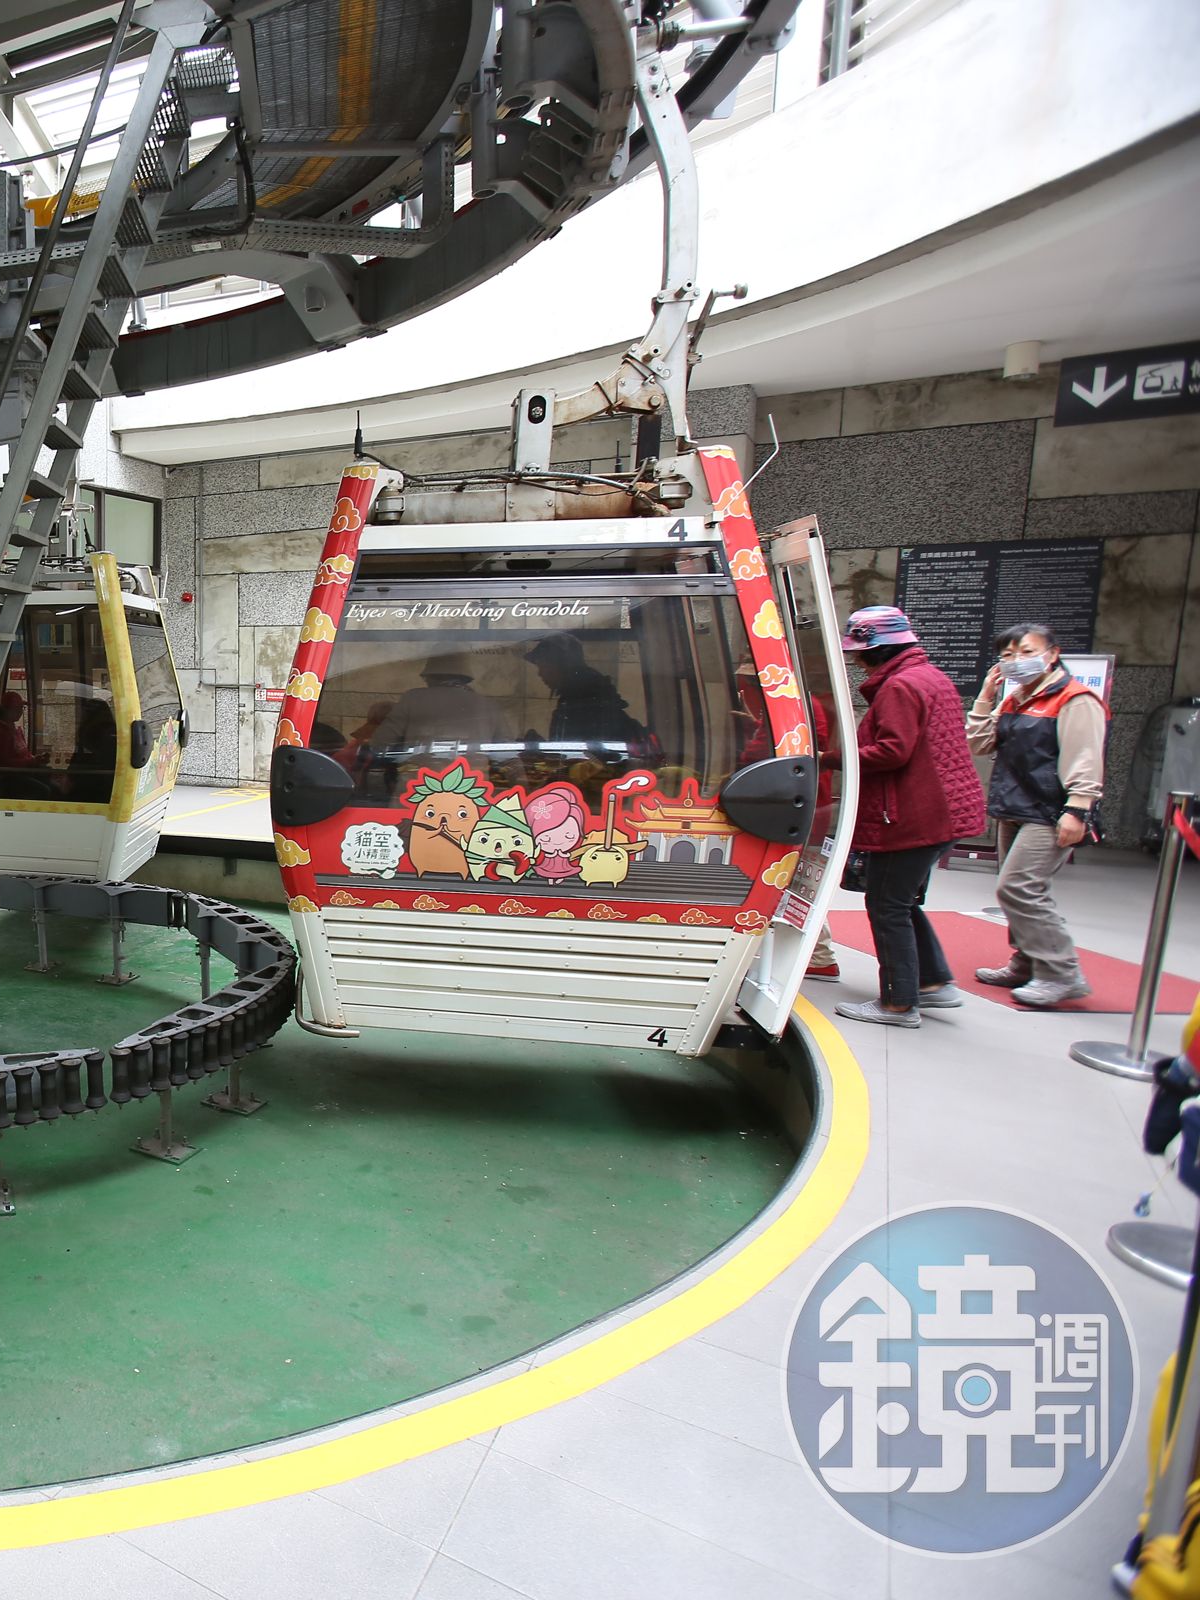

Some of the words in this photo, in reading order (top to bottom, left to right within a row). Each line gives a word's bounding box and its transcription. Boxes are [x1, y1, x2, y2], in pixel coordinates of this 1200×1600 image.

[667, 518, 688, 541] 4
[344, 603, 386, 622] Eyes
[418, 601, 506, 622] Maokong
[511, 600, 590, 617] Gondola
[354, 830, 392, 848] 貓空
[353, 848, 392, 860] 小精靈
[647, 1027, 668, 1048] 4
